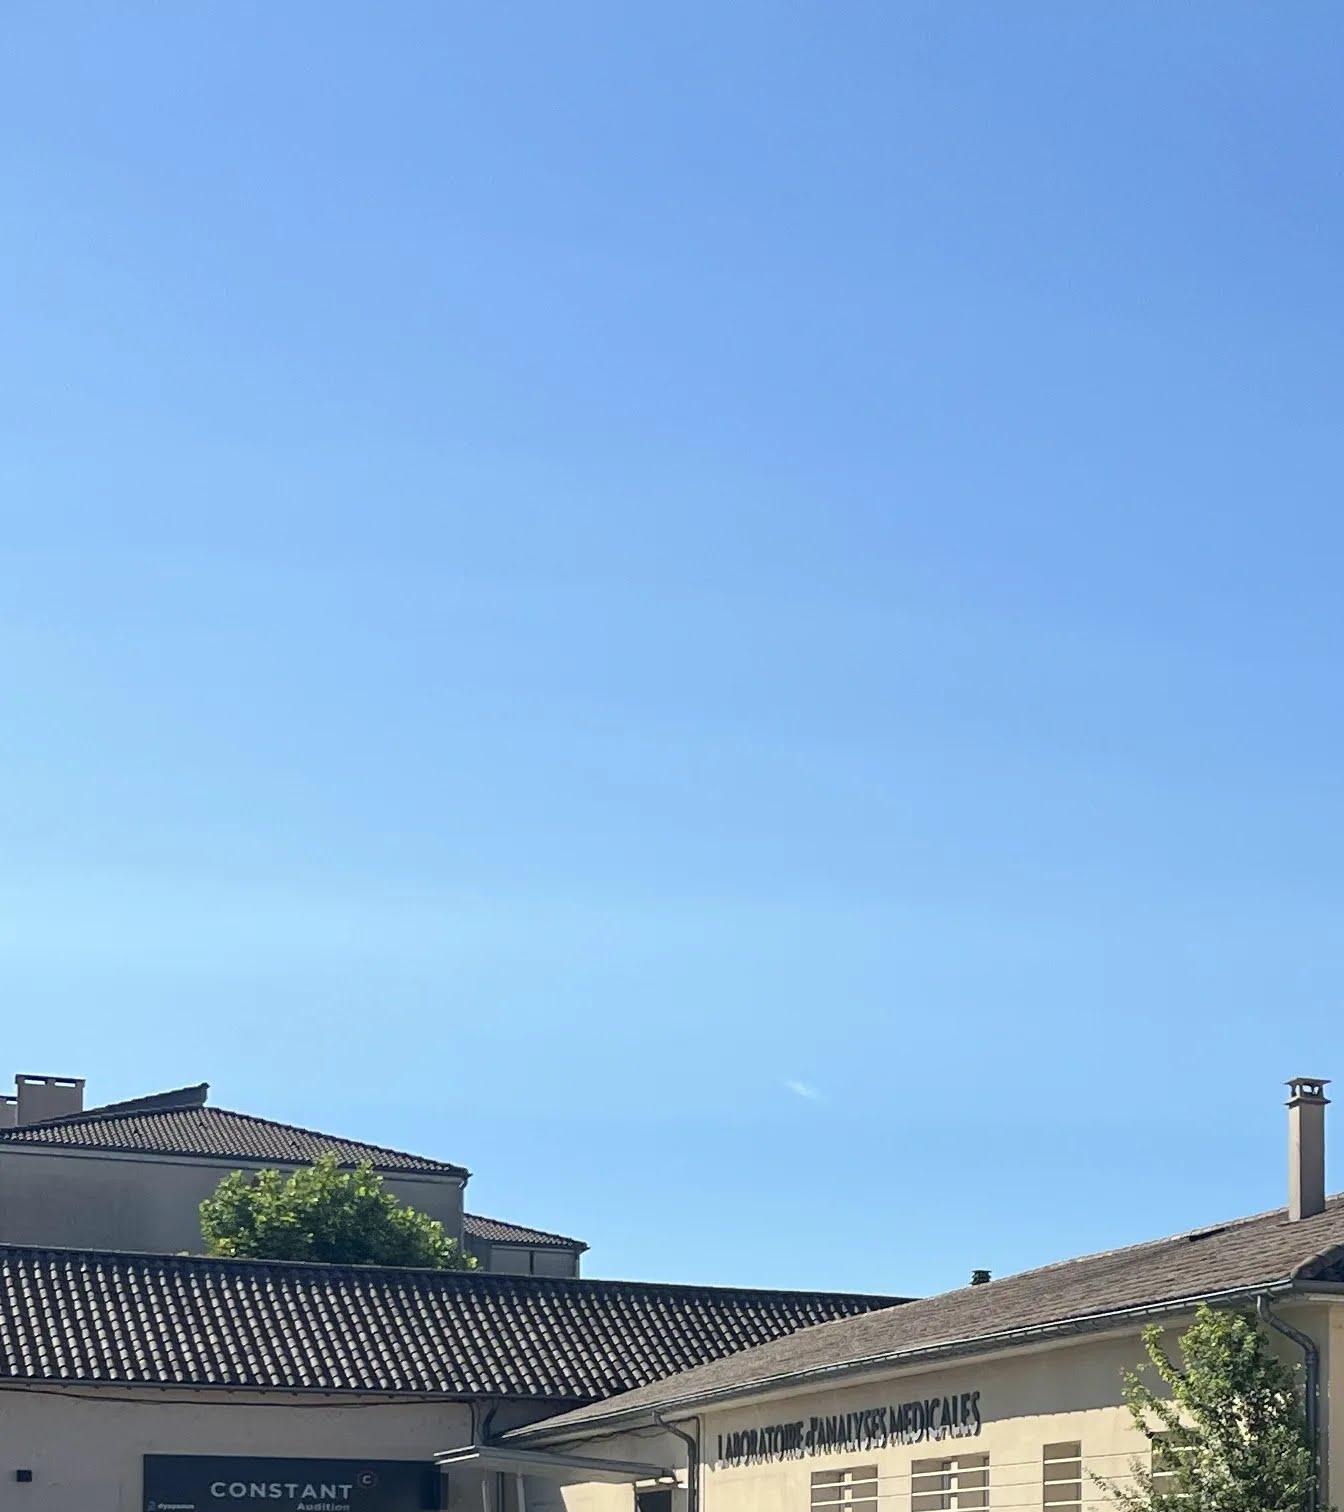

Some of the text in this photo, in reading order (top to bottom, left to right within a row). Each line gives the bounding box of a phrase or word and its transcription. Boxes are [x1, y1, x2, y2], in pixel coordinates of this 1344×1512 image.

[717, 1420, 804, 1461] LABORATOIRE
[210, 1481, 352, 1500] CONSTANT
[297, 1502, 351, 1512] Audition
